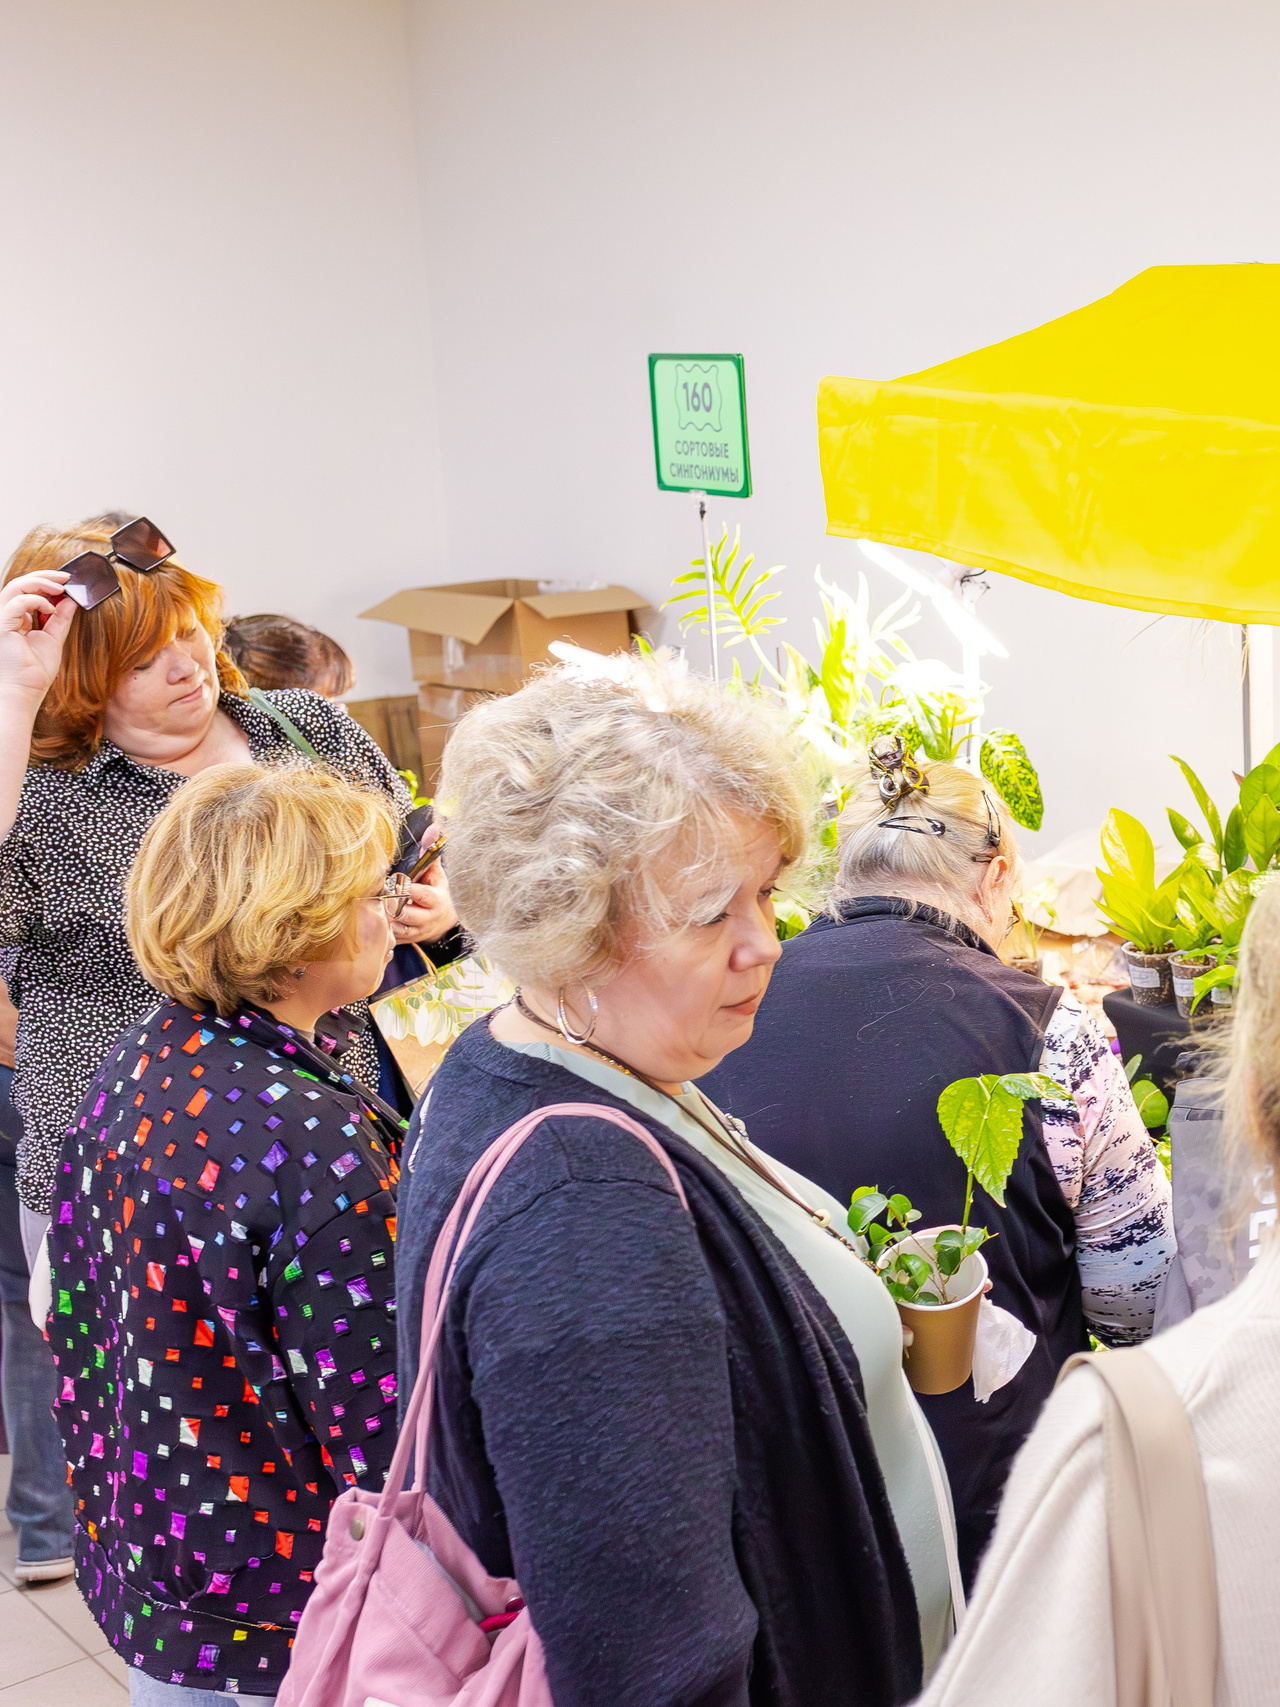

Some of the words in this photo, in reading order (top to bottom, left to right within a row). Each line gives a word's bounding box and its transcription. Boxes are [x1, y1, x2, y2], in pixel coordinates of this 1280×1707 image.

[682, 381, 713, 412] 160
[675, 439, 729, 459] СОРТОВЫЕ
[669, 462, 739, 483] СИНГОНИУМЫ
